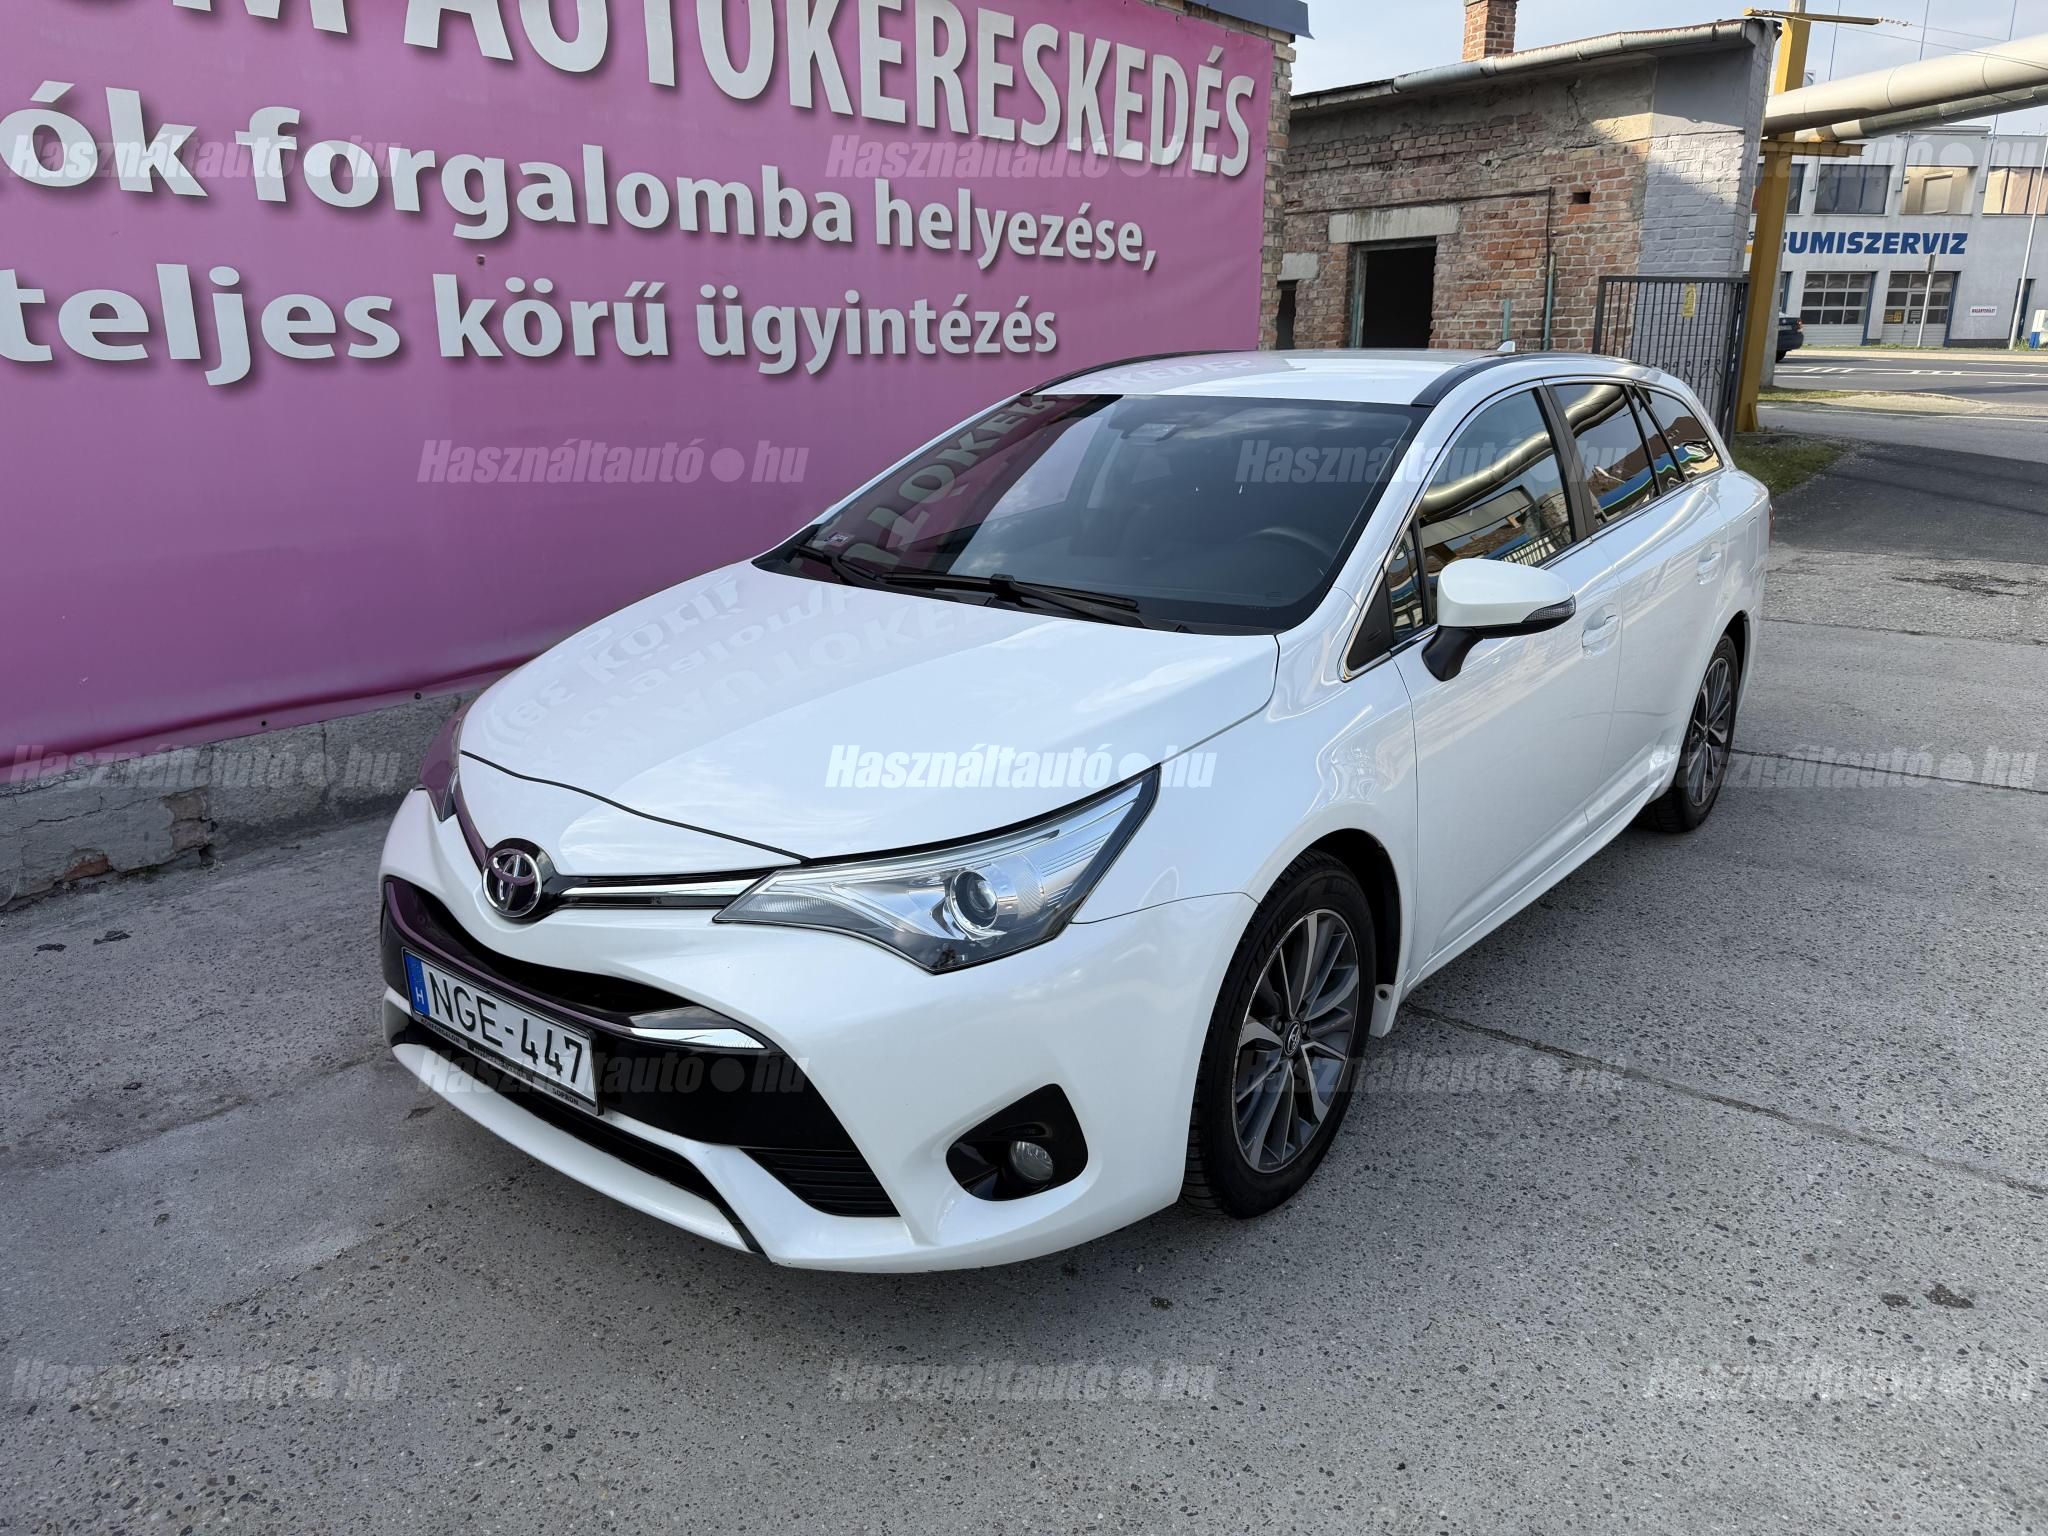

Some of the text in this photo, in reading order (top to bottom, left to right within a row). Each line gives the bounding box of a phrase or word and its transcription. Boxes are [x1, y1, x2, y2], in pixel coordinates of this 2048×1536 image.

[235, 106, 853, 240] forgalomba
[875, 178, 1158, 271] helyezése,
[1783, 231, 1969, 255] UMISZERVIZ
[0, 263, 1058, 386] teljes körű ügyintézés
[415, 986, 425, 1005] H
[428, 971, 583, 1084] NGE-447
